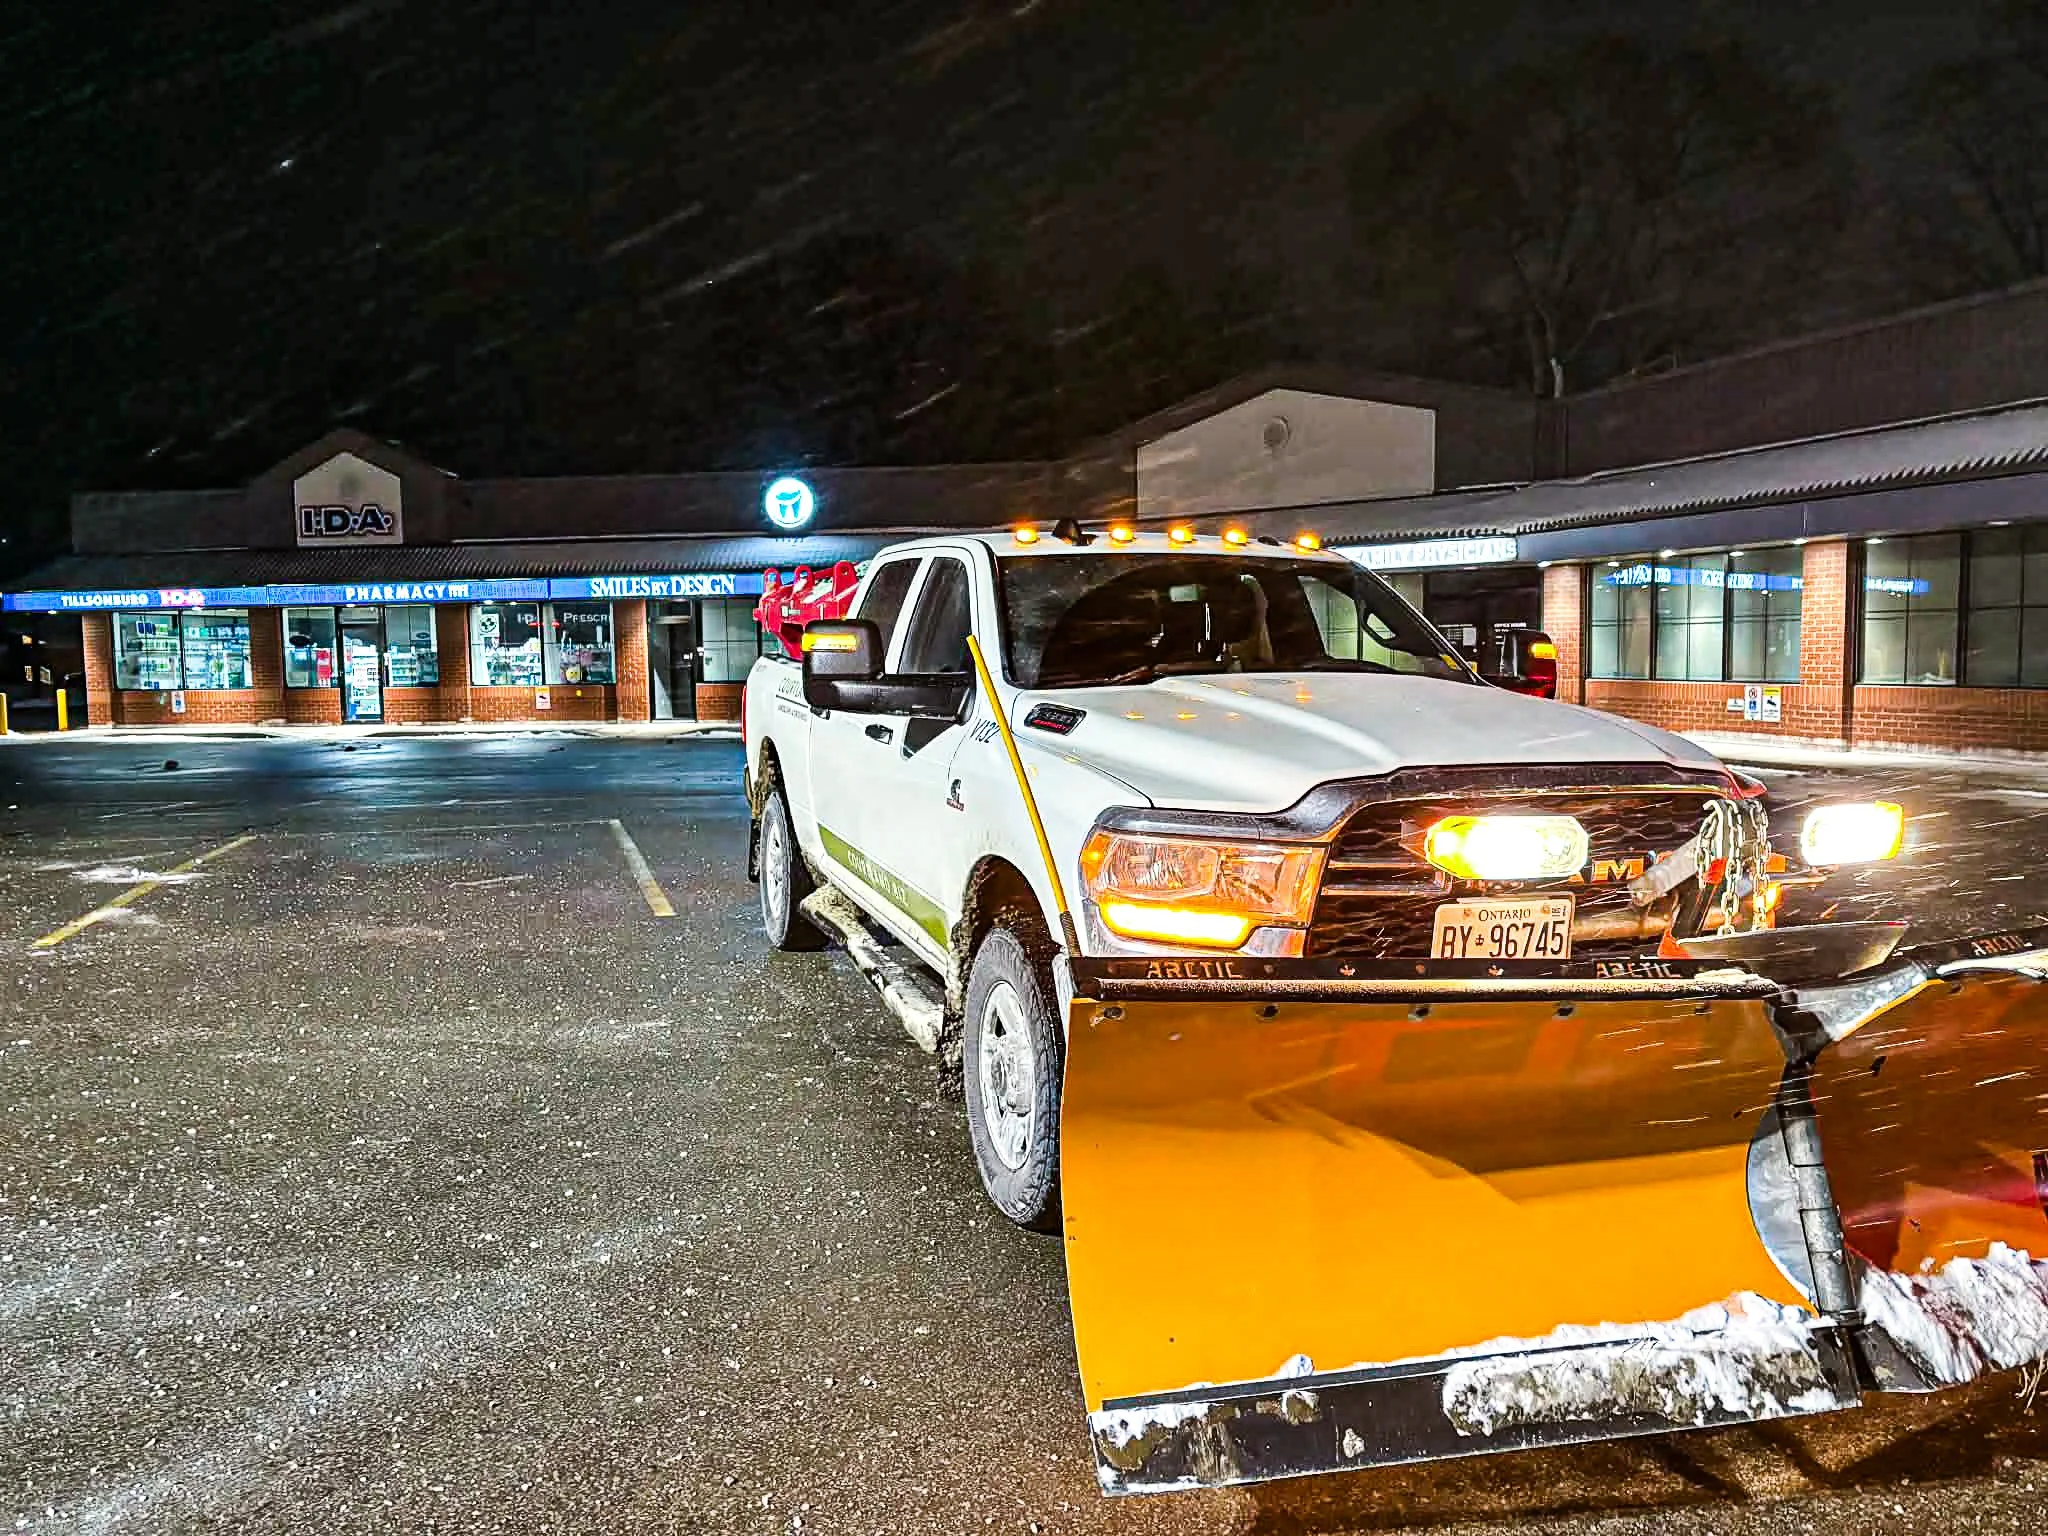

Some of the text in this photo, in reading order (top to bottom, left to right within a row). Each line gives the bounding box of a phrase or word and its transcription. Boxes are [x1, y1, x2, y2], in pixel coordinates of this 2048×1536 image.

[1413, 541, 1516, 562] PHYSICIANS
[345, 585, 447, 600] PHARMACY
[591, 574, 736, 597] SMILES BY DESIGN
[1479, 908, 1531, 922] ONTARIO
[1489, 920, 1565, 958] 96745
[1147, 961, 1242, 979] ARCTIC
[1596, 962, 1682, 978] ARCTIC
